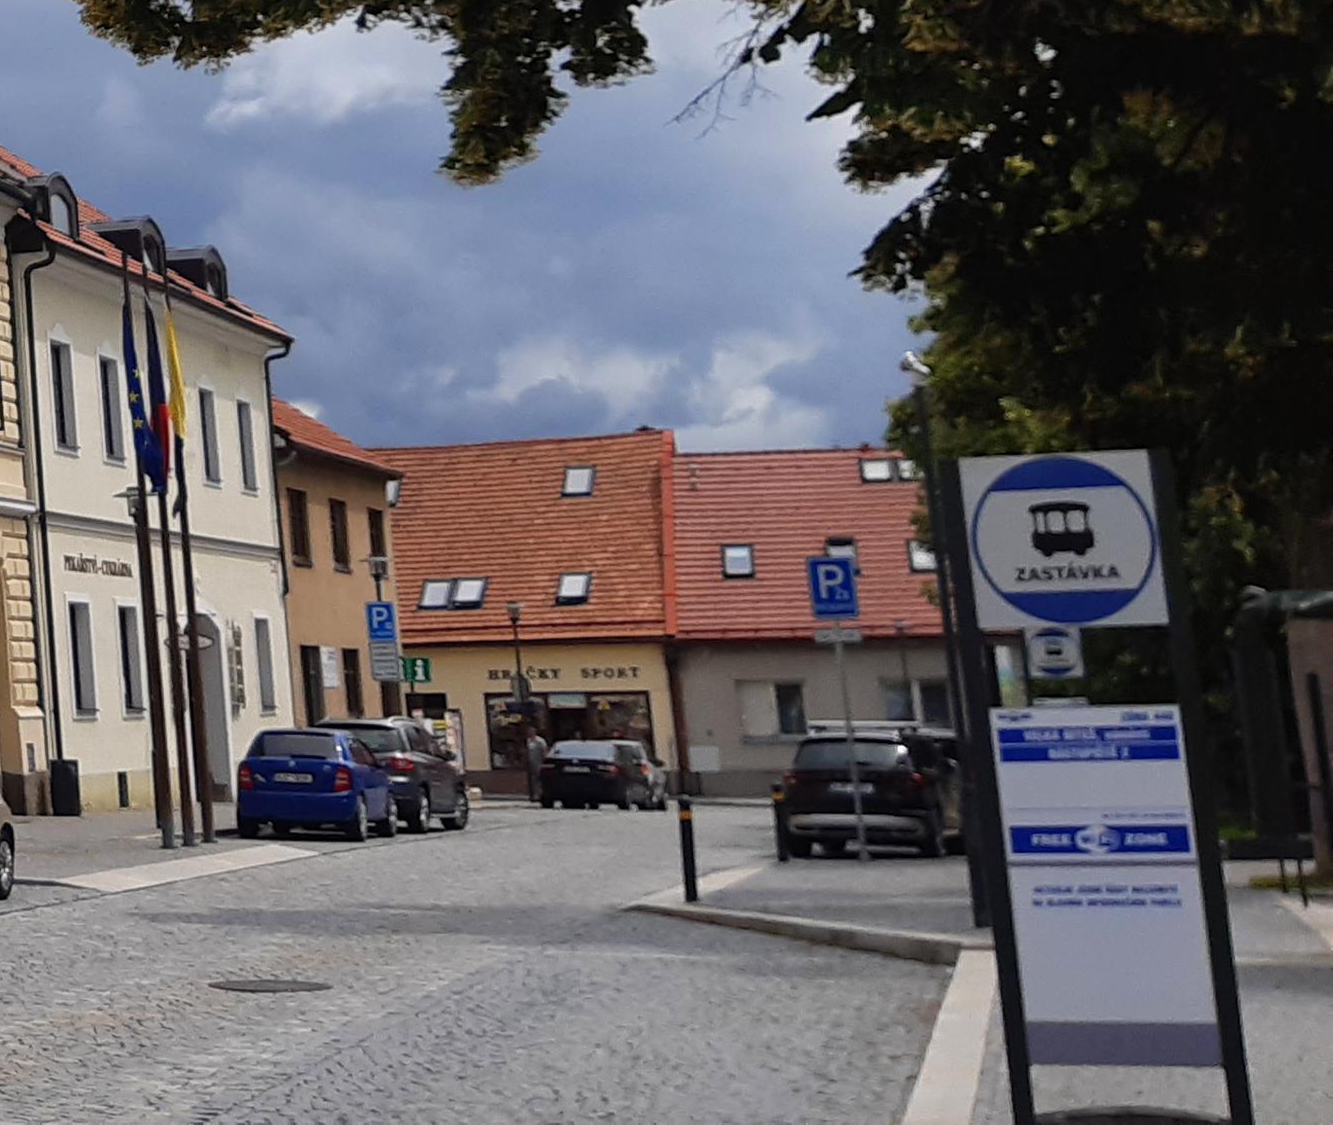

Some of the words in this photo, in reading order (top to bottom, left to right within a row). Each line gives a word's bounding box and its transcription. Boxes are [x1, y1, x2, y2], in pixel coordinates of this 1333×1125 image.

[1015, 562, 1121, 581] ZASTÁVKA
[487, 666, 561, 680] HRČKY
[580, 666, 641, 679] SPORT
